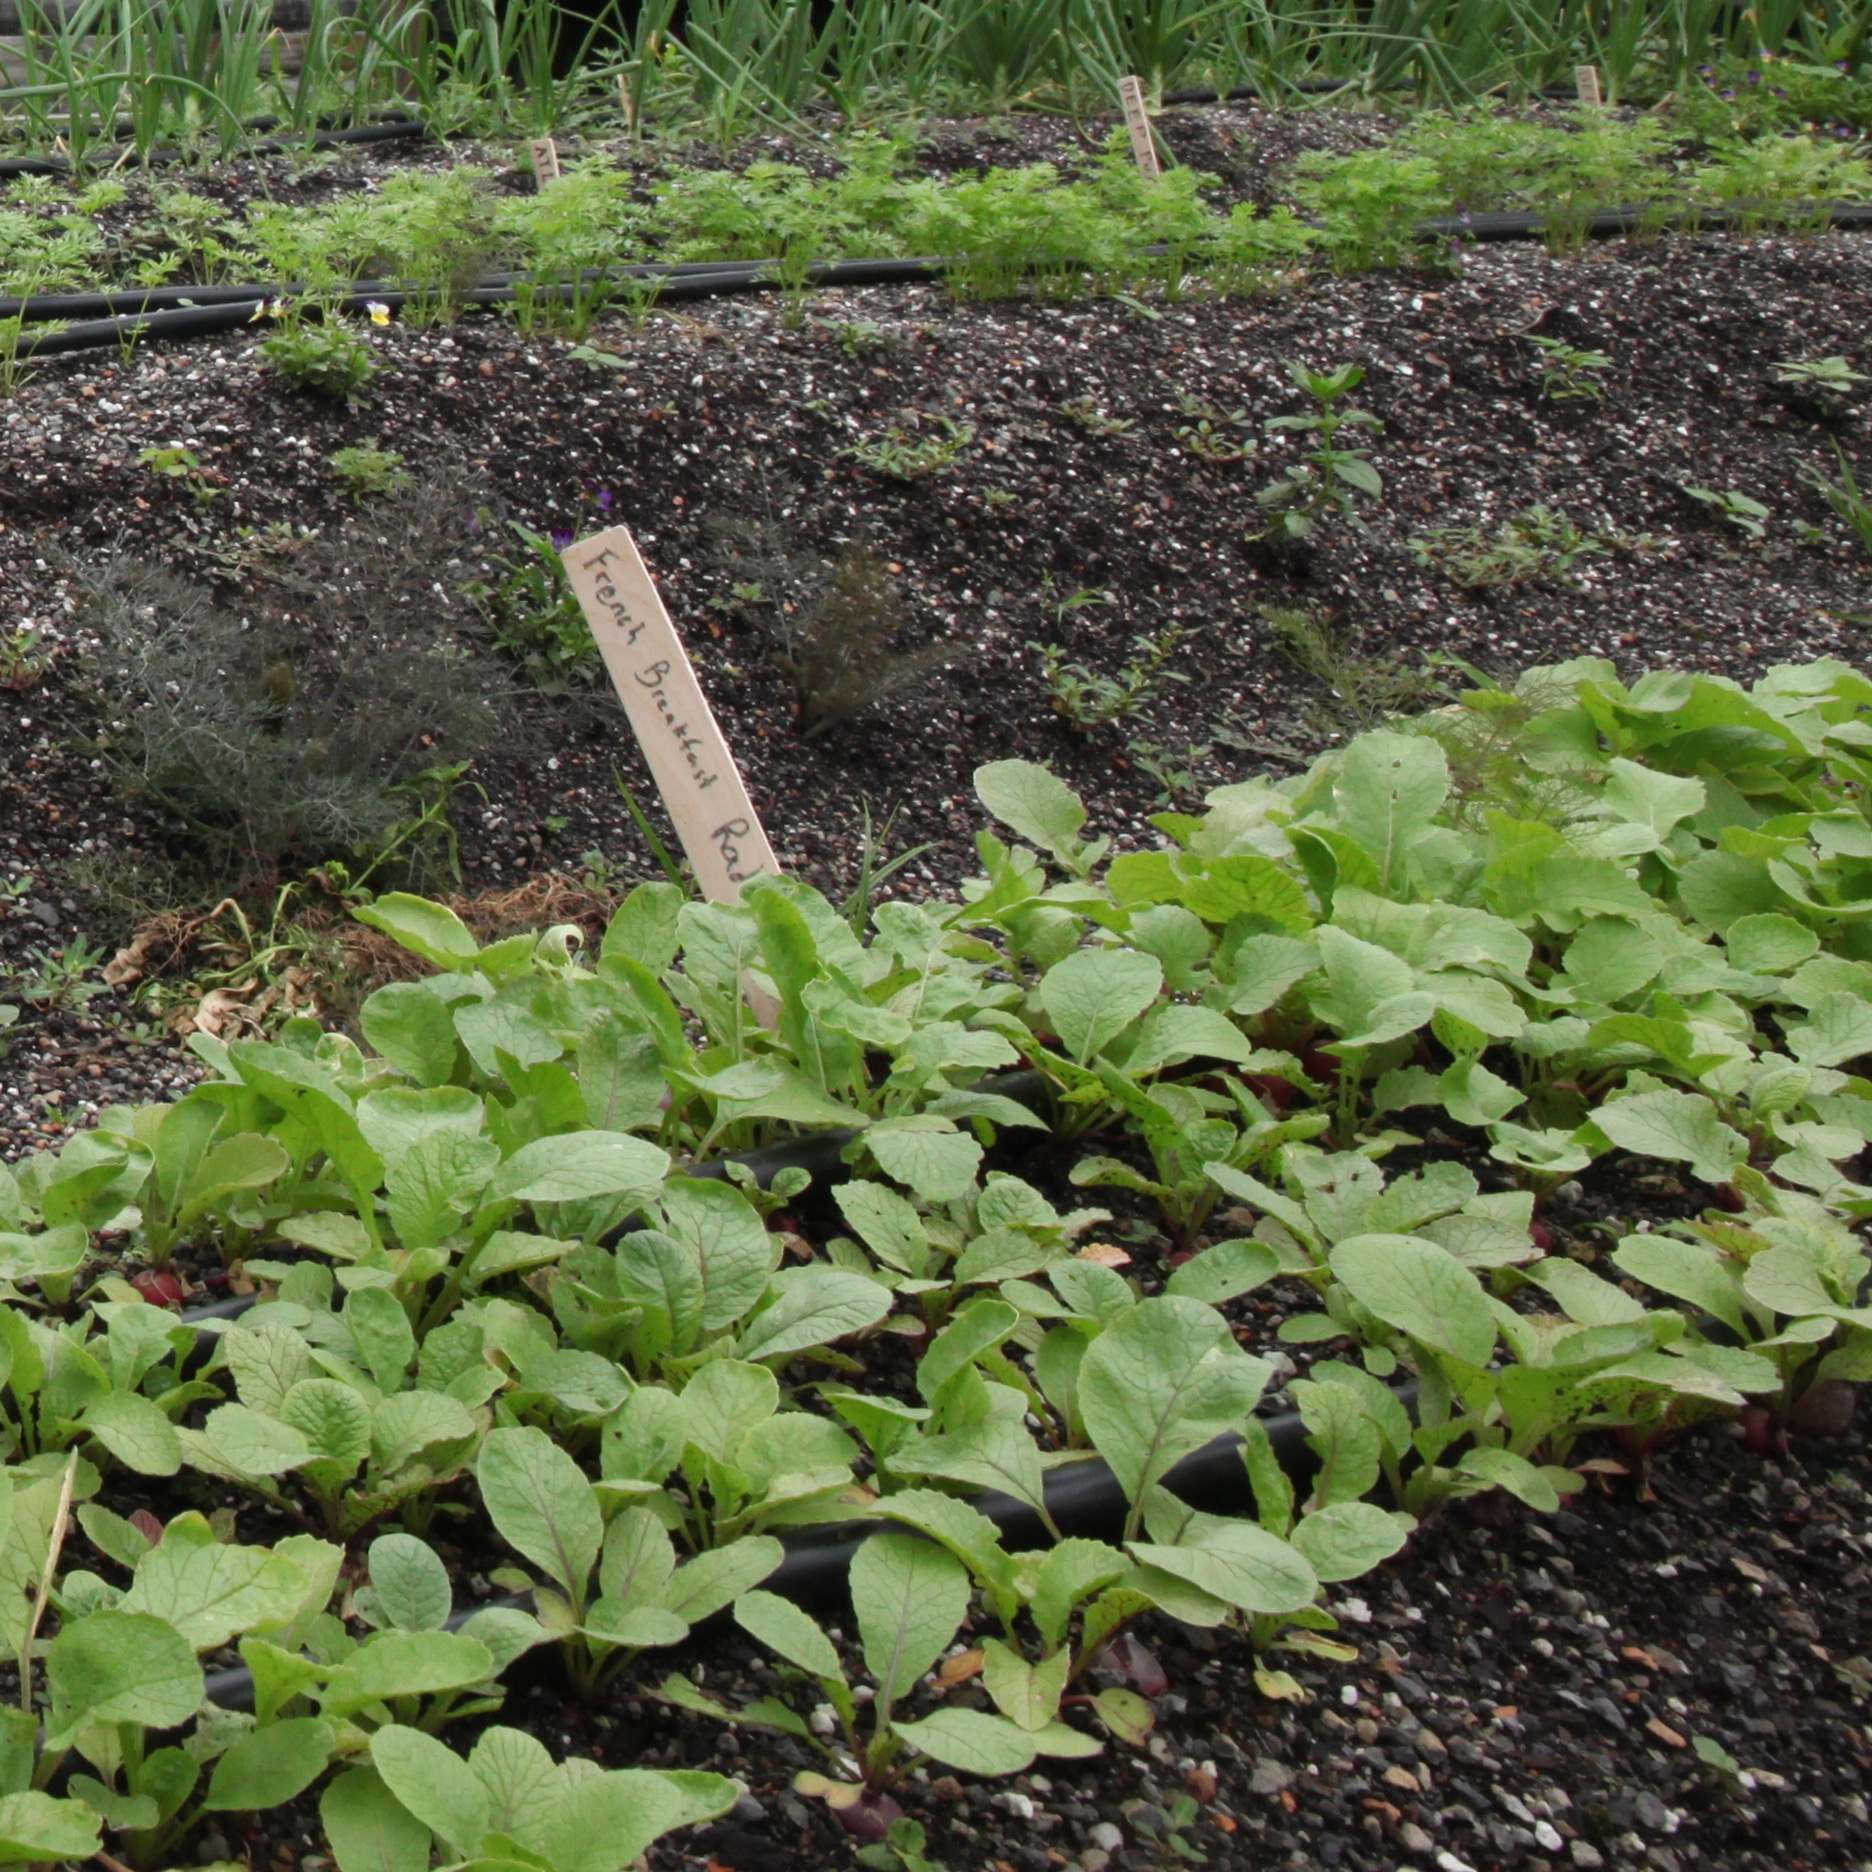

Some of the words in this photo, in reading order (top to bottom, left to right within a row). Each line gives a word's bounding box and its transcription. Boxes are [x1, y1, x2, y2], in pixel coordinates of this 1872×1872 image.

[1120, 81, 1146, 138] DEEP
[581, 546, 649, 646] French
[633, 658, 720, 791] Breakfast
